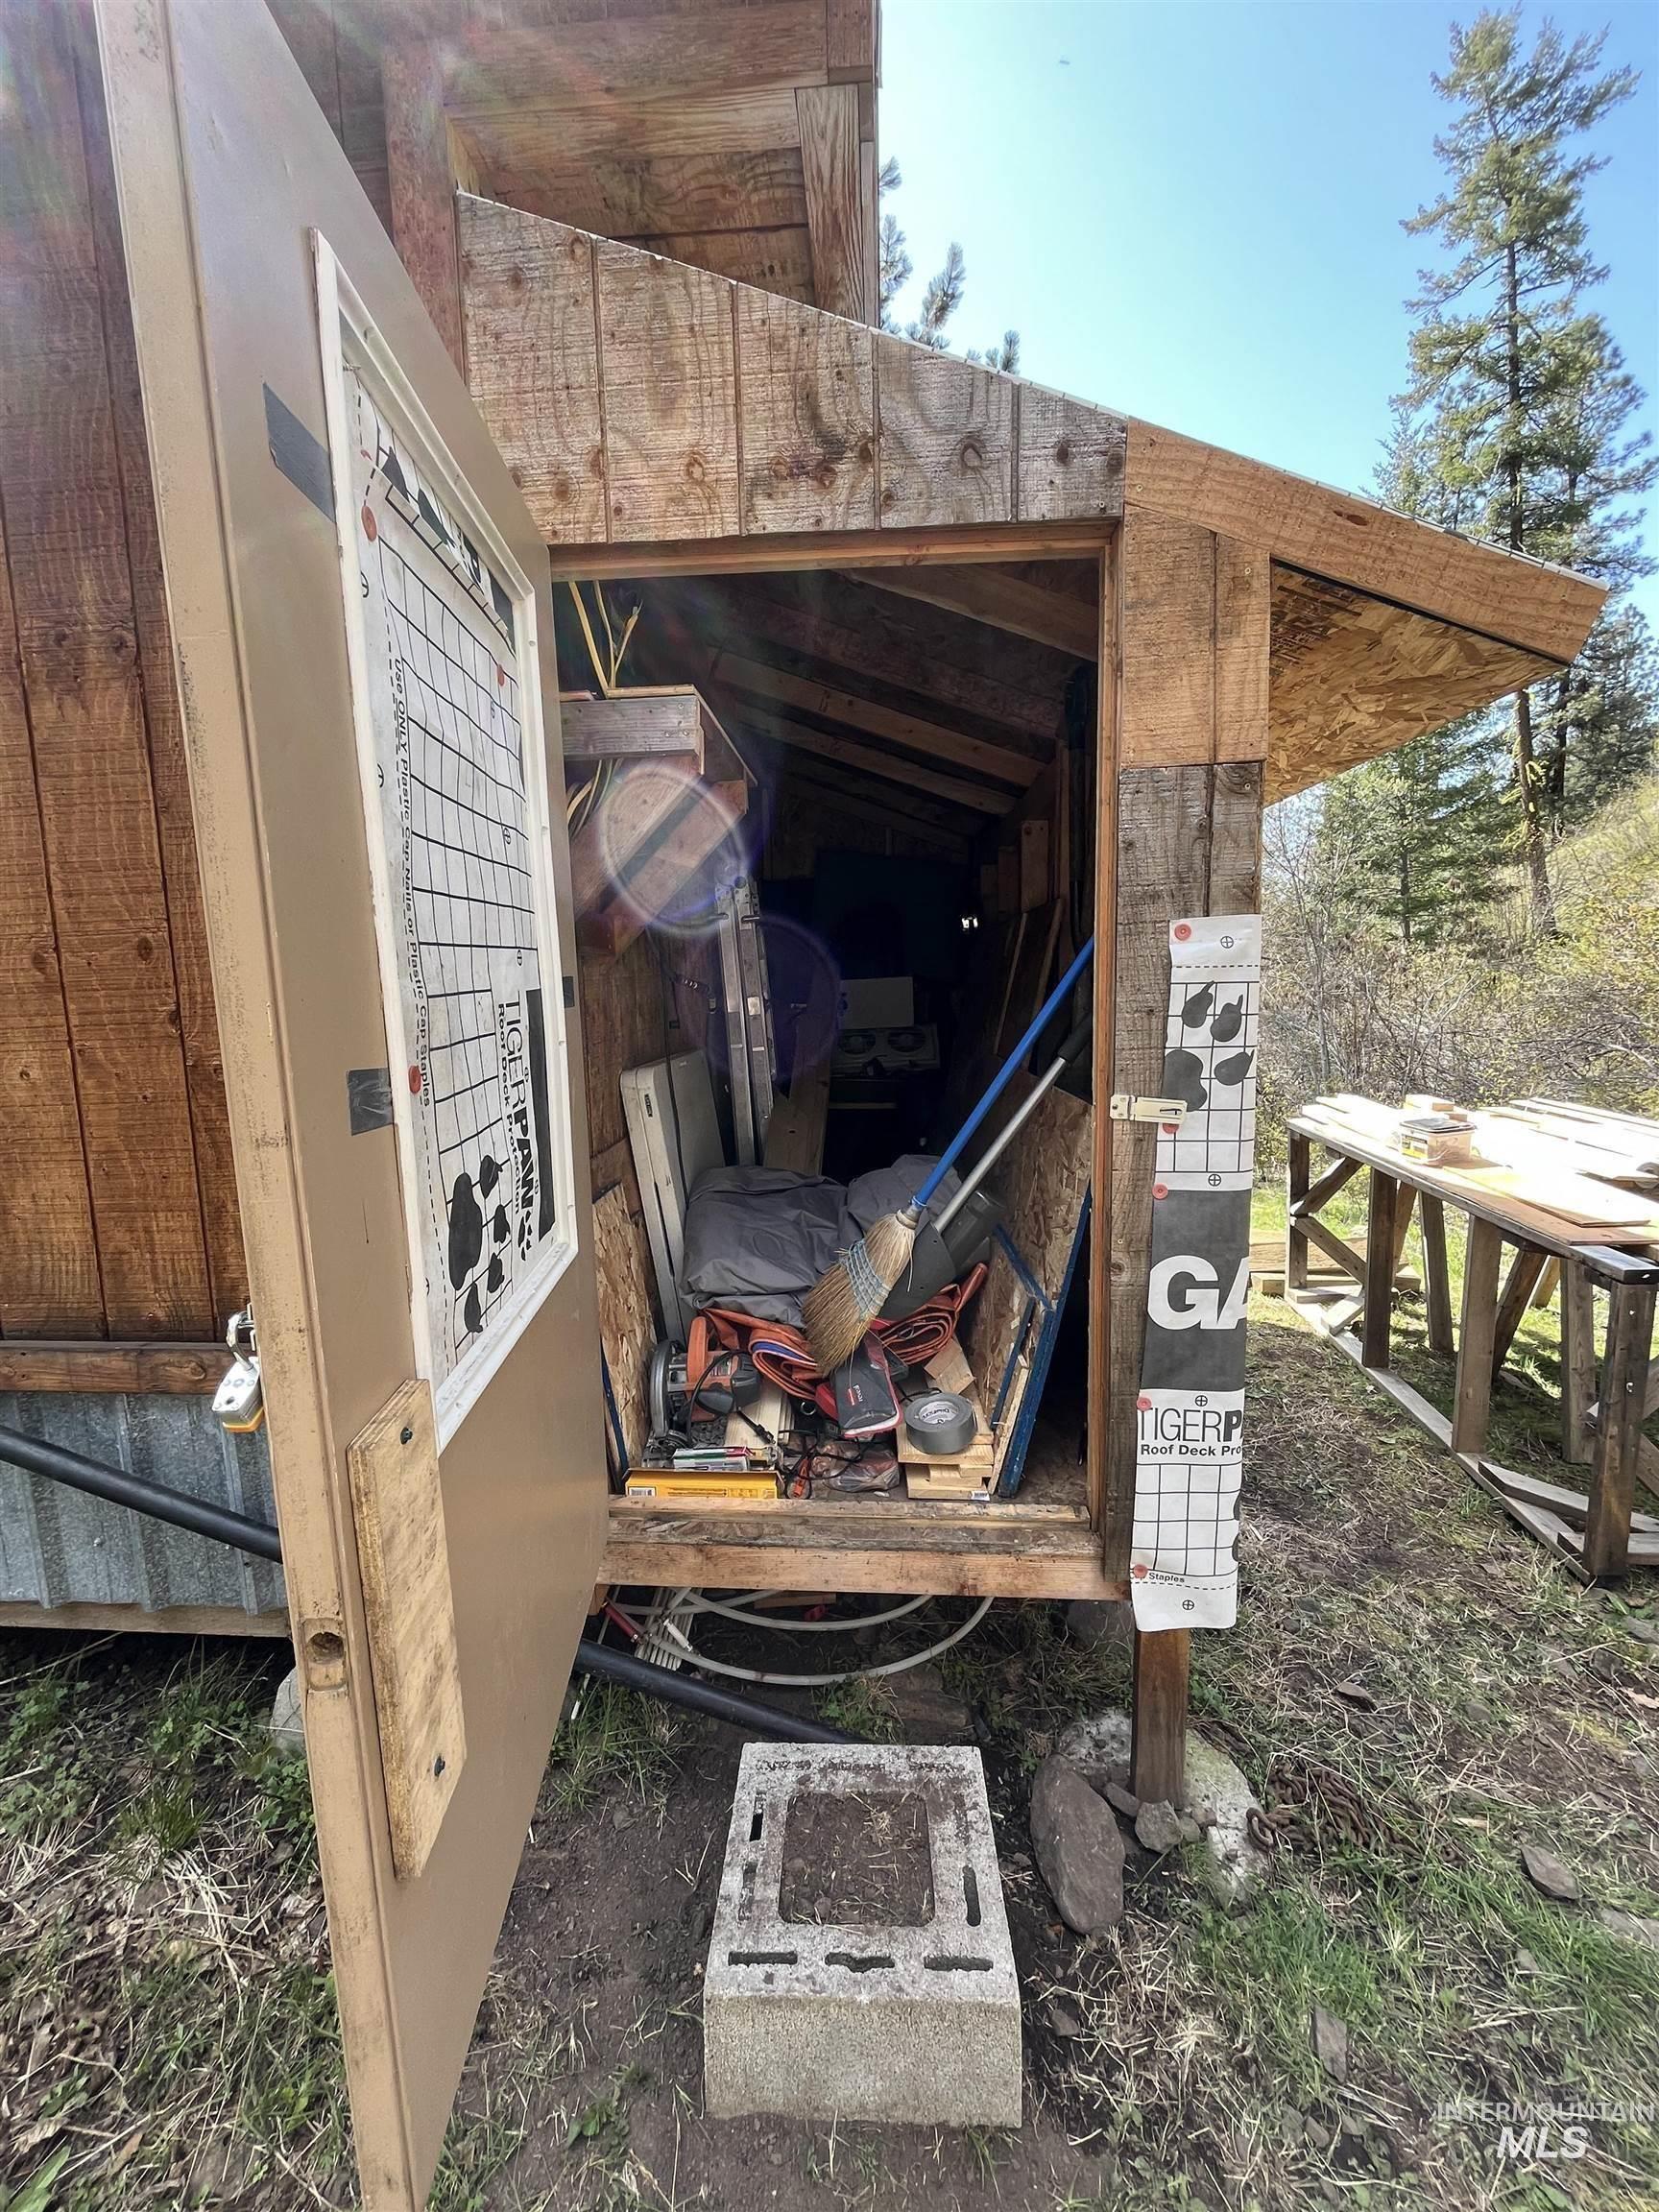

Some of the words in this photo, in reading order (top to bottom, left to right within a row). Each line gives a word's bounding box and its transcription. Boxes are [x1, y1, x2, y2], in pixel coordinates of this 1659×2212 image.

[397, 701, 408, 753] ONLY
[401, 758, 410, 821] Plastic
[407, 918, 415, 937] or
[410, 942, 424, 999] Plastic
[420, 1045, 430, 1107] Staples
[505, 990, 534, 1210] TIGERPAW
[502, 1056, 511, 1107] Deck
[507, 1114, 521, 1215] Protection
[1137, 1407, 1243, 1443] TIGERP
[1141, 1444, 1174, 1455] Roof
[1178, 1444, 1216, 1456] Deck
[1148, 1572, 1185, 1583] Staples
